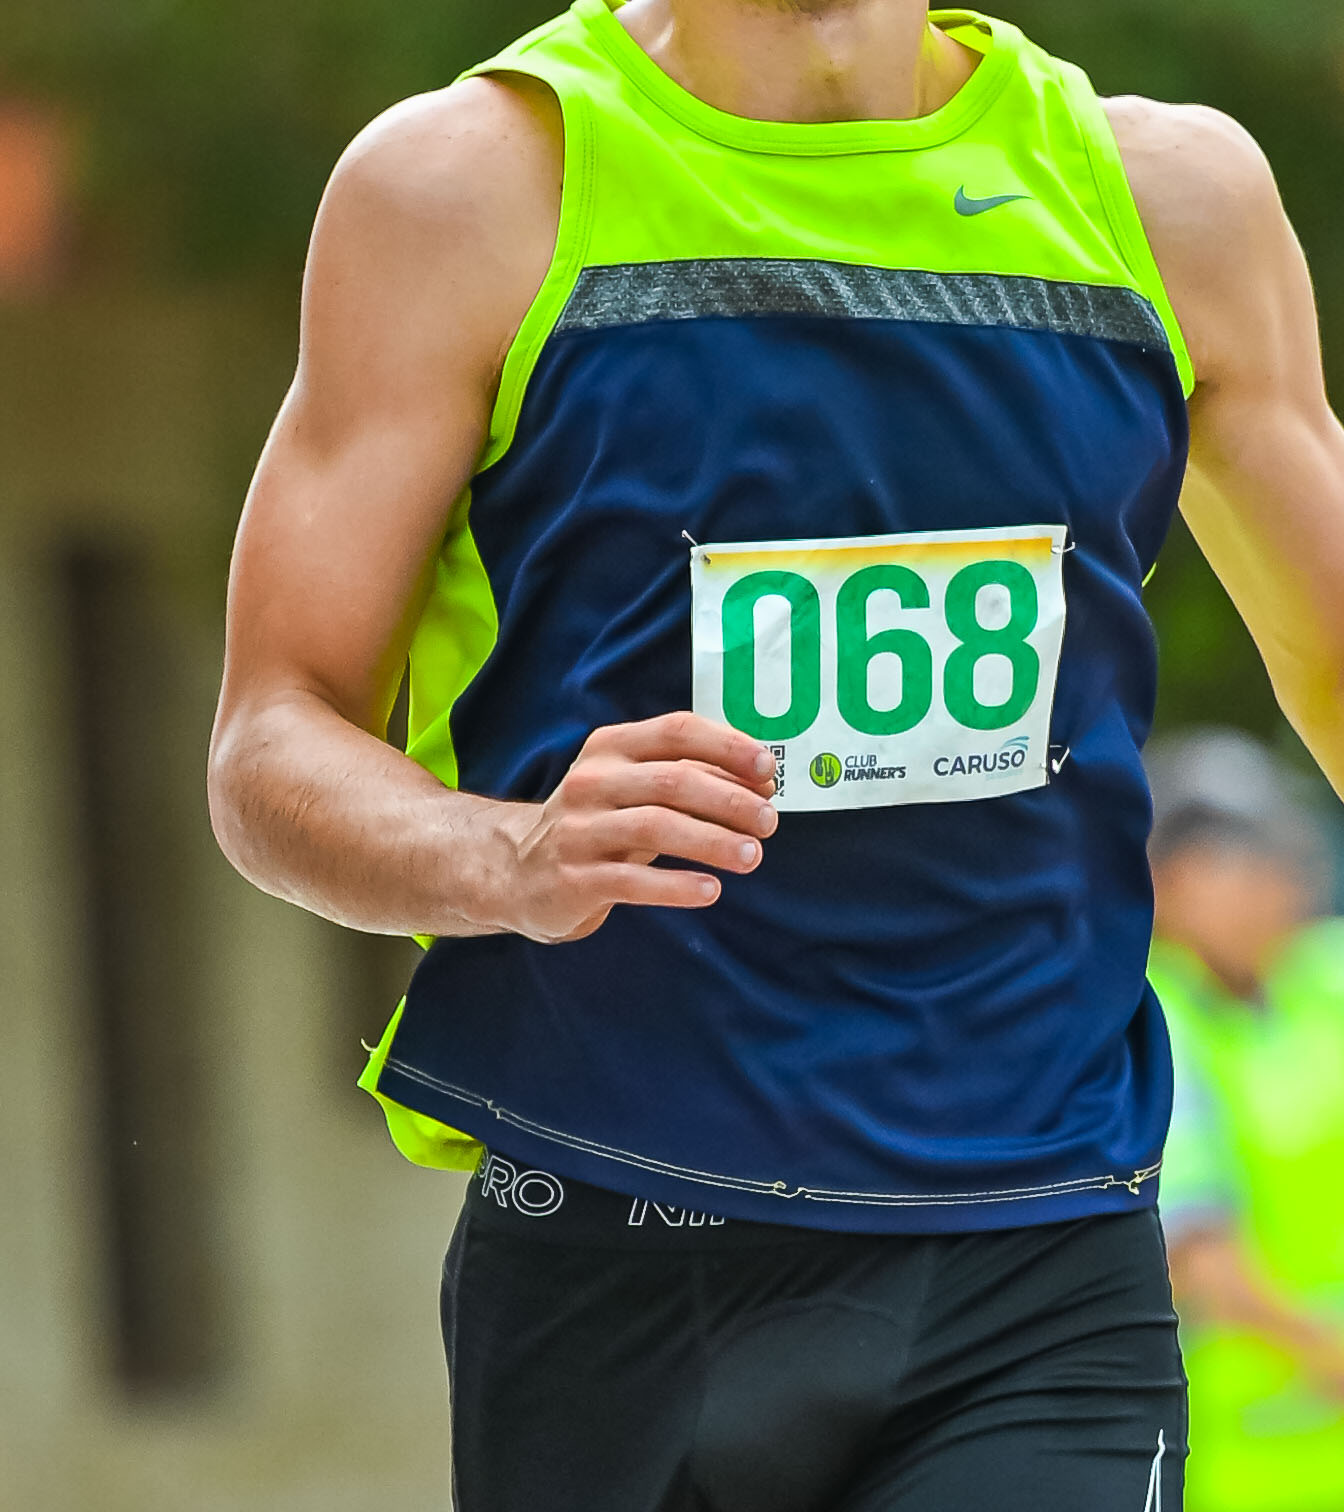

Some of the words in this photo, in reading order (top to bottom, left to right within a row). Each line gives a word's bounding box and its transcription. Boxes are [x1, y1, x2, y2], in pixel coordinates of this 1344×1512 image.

[721, 559, 1040, 741] 068
[844, 754, 877, 768] CLUB
[933, 749, 1025, 776] CARUSO
[843, 766, 907, 781] RUNNER'S
